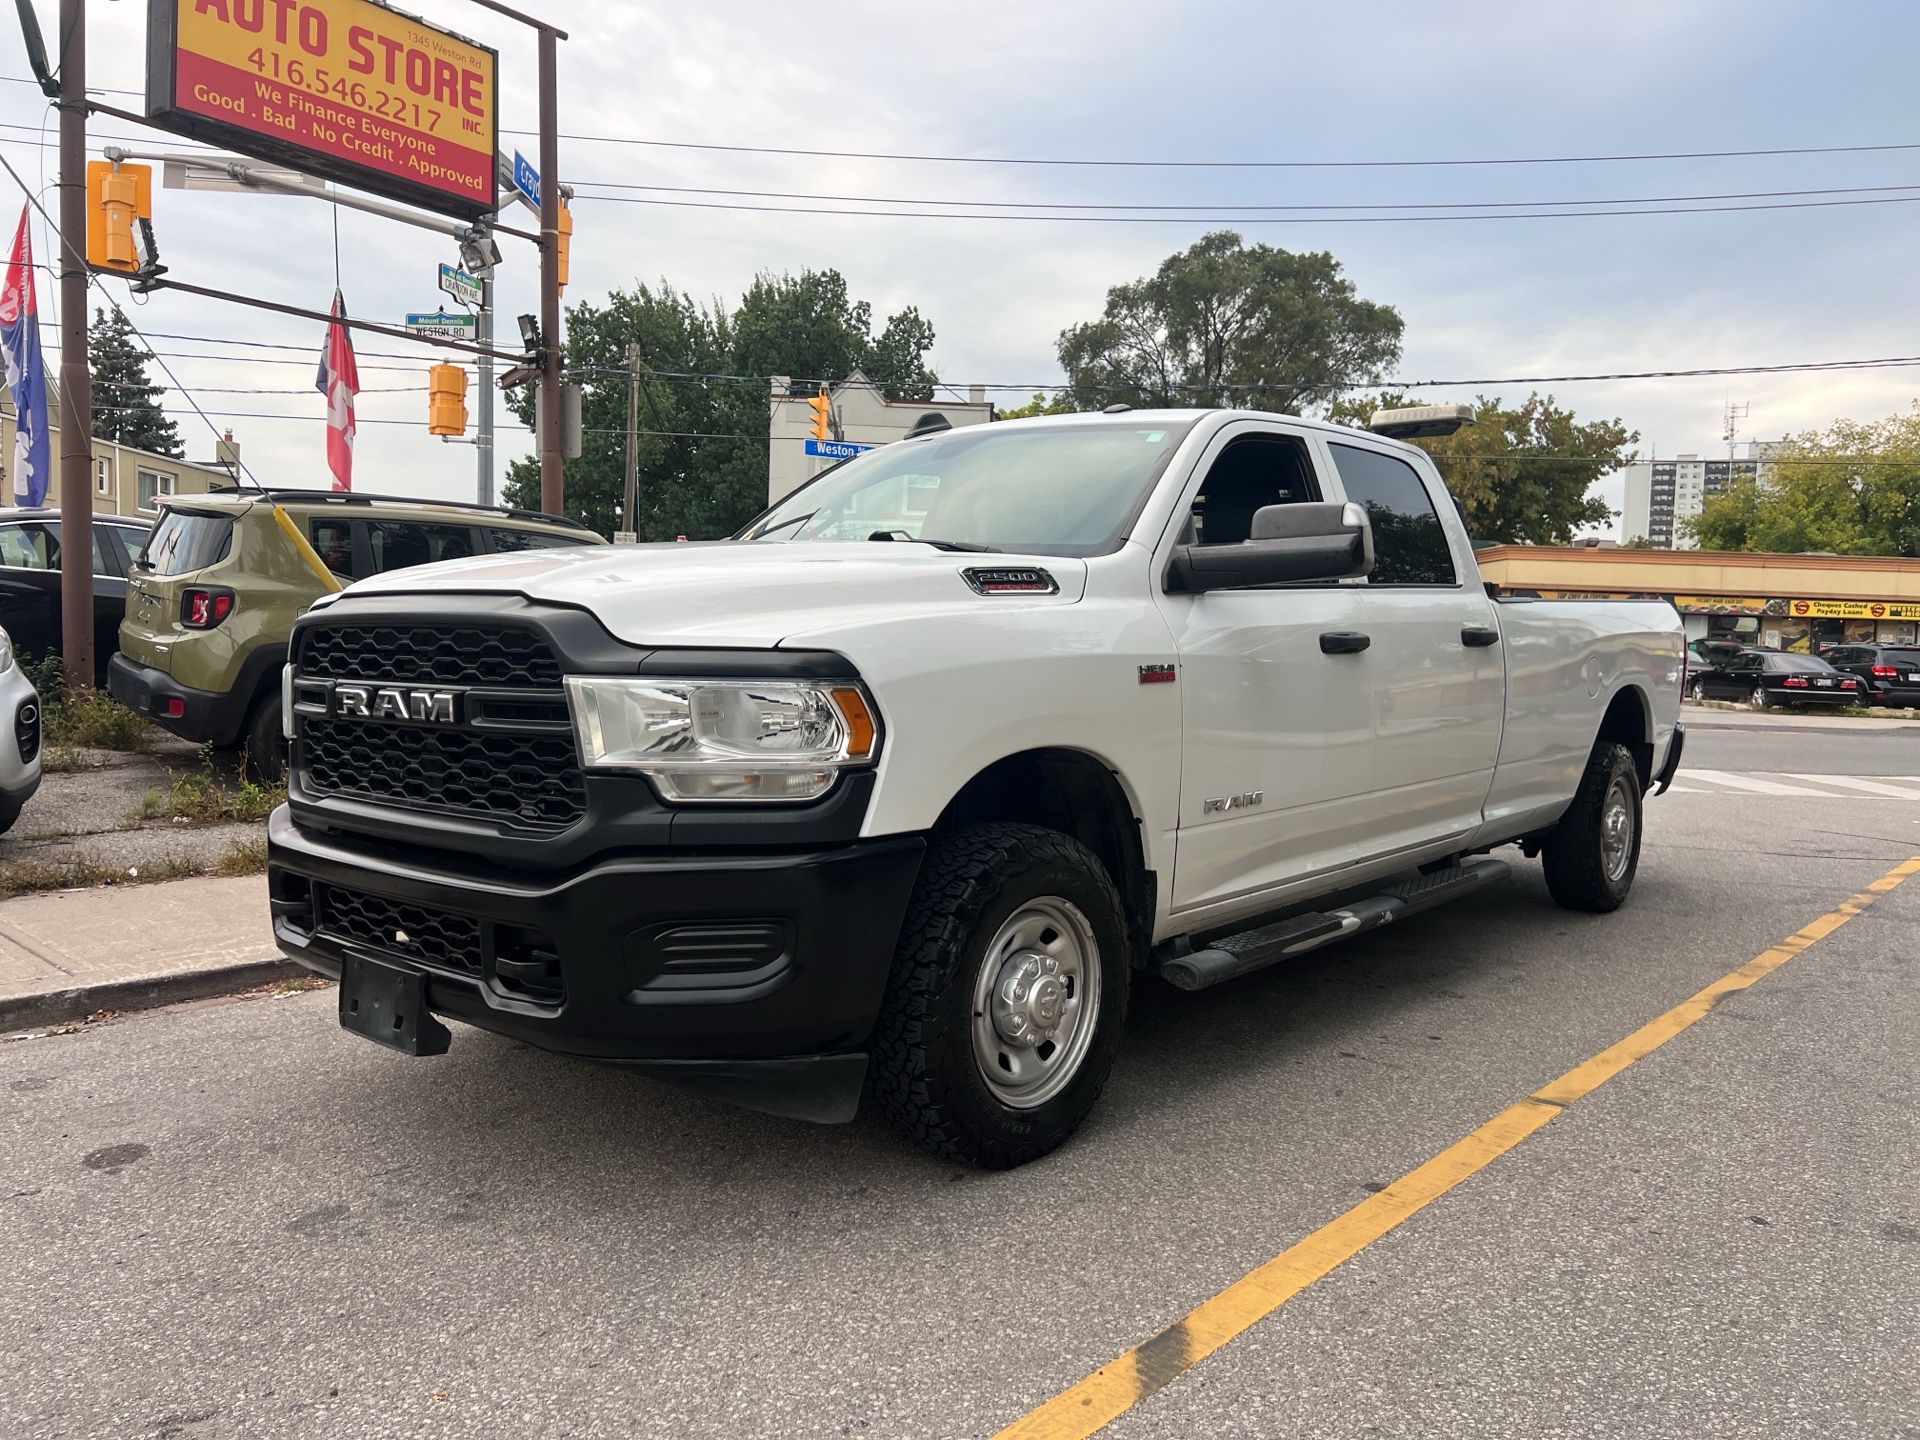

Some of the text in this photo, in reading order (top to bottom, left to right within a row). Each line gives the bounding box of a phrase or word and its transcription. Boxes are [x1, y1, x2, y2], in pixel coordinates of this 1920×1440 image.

[407, 31, 484, 70] 1345 Weston Rd.
[348, 25, 485, 118] STORE
[247, 47, 441, 132] 416.546.2217
[254, 81, 436, 155] We Finance Everyone
[462, 117, 485, 136] INC.
[193, 84, 245, 114] Good
[263, 105, 296, 130] Bad
[313, 122, 337, 143] No
[342, 132, 394, 162] Credit
[408, 155, 483, 190] Approved
[520, 161, 540, 199] Crayd
[415, 326, 449, 337] WESTON
[441, 317, 464, 325] Dennis
[816, 442, 854, 456] Weston
[978, 572, 1038, 582] 2500
[1813, 601, 1841, 609] Cheques
[1137, 664, 1175, 674] HEMI
[335, 685, 456, 722] RAM
[1204, 790, 1263, 814] RAM
